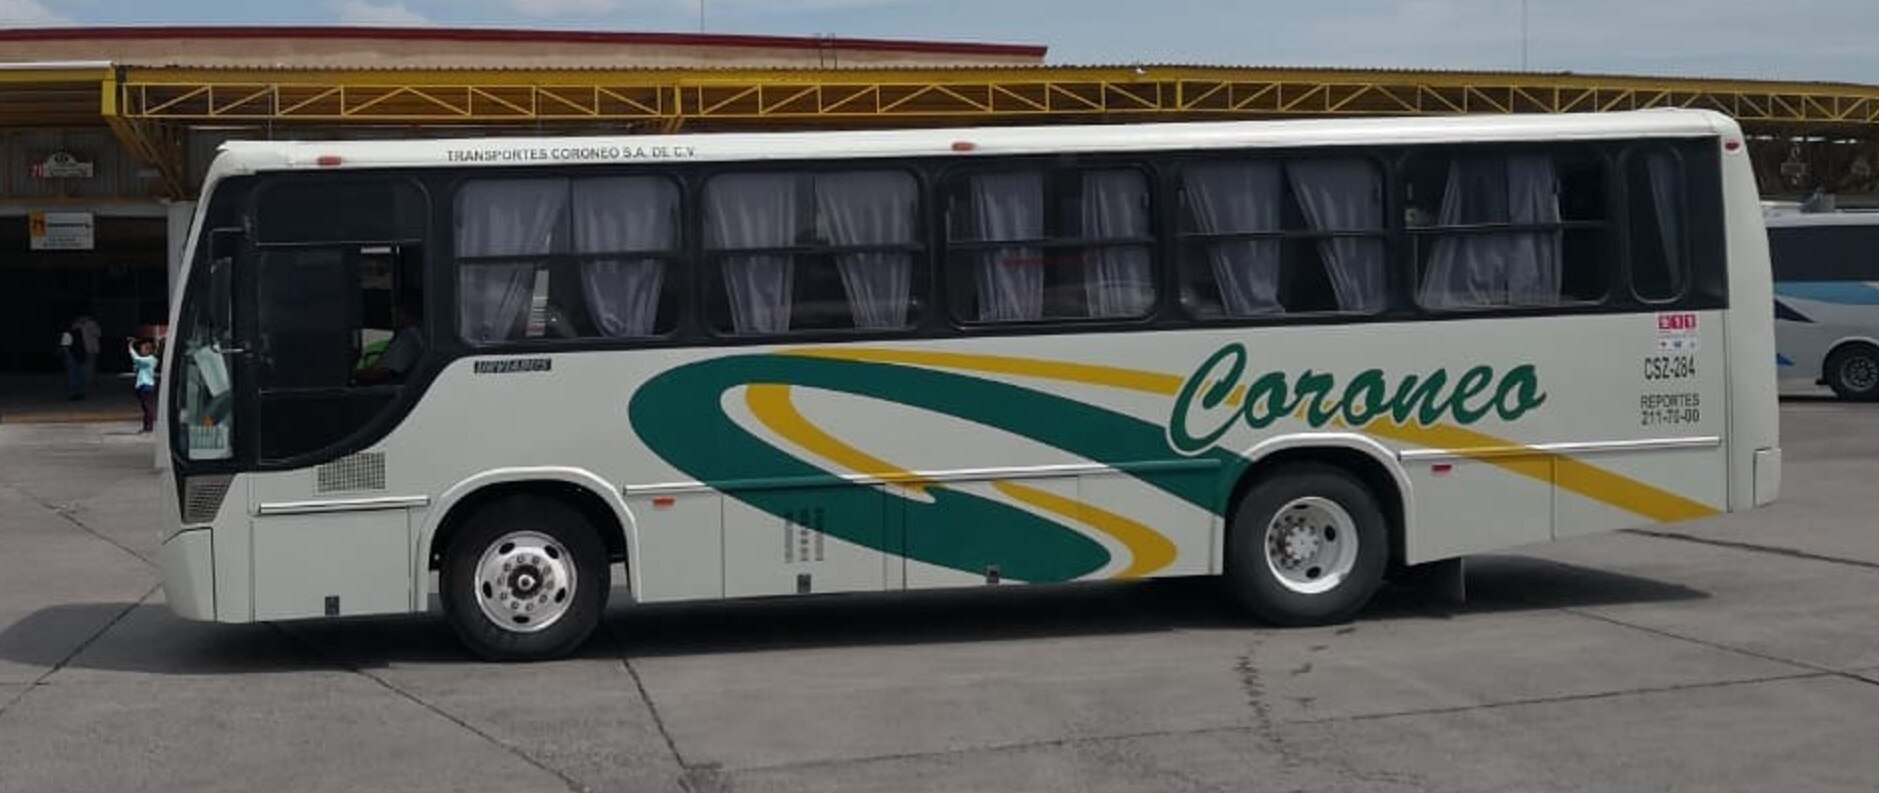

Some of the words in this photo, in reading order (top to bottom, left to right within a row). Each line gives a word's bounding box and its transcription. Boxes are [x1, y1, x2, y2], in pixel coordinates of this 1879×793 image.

[447, 148, 548, 161] TRANSPORTES
[550, 146, 620, 160] CORONEO
[1658, 314, 1696, 330] 911
[1644, 355, 1696, 380] CSZ-284
[1169, 342, 1547, 455] Coroneo
[1640, 393, 1700, 409] REPORTES
